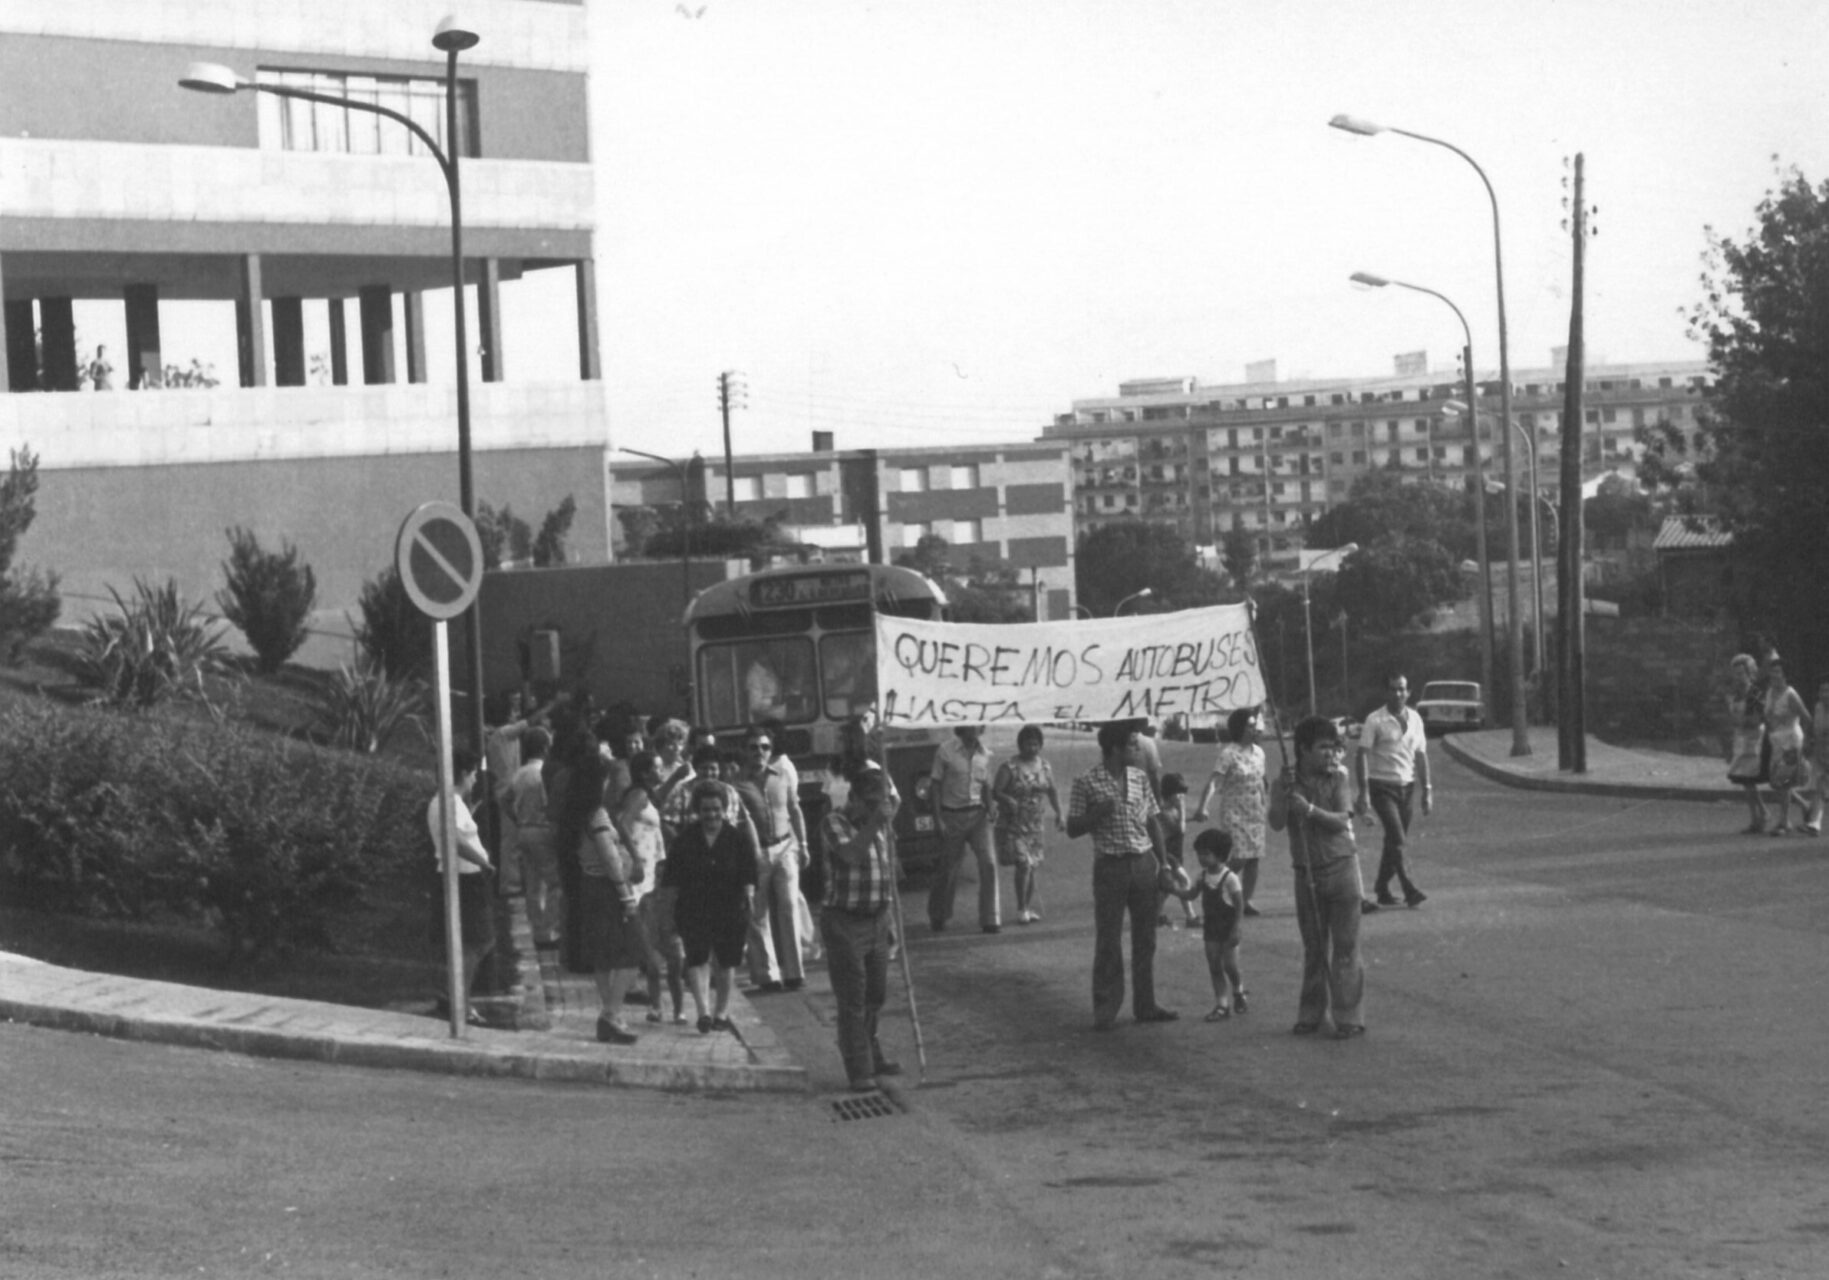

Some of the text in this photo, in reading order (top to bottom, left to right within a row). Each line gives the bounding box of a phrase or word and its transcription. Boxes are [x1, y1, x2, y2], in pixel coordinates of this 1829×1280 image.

[895, 628, 1257, 688] QUEREMOS AUTOBUSES
[884, 670, 1252, 723] HASTA EL METRO
